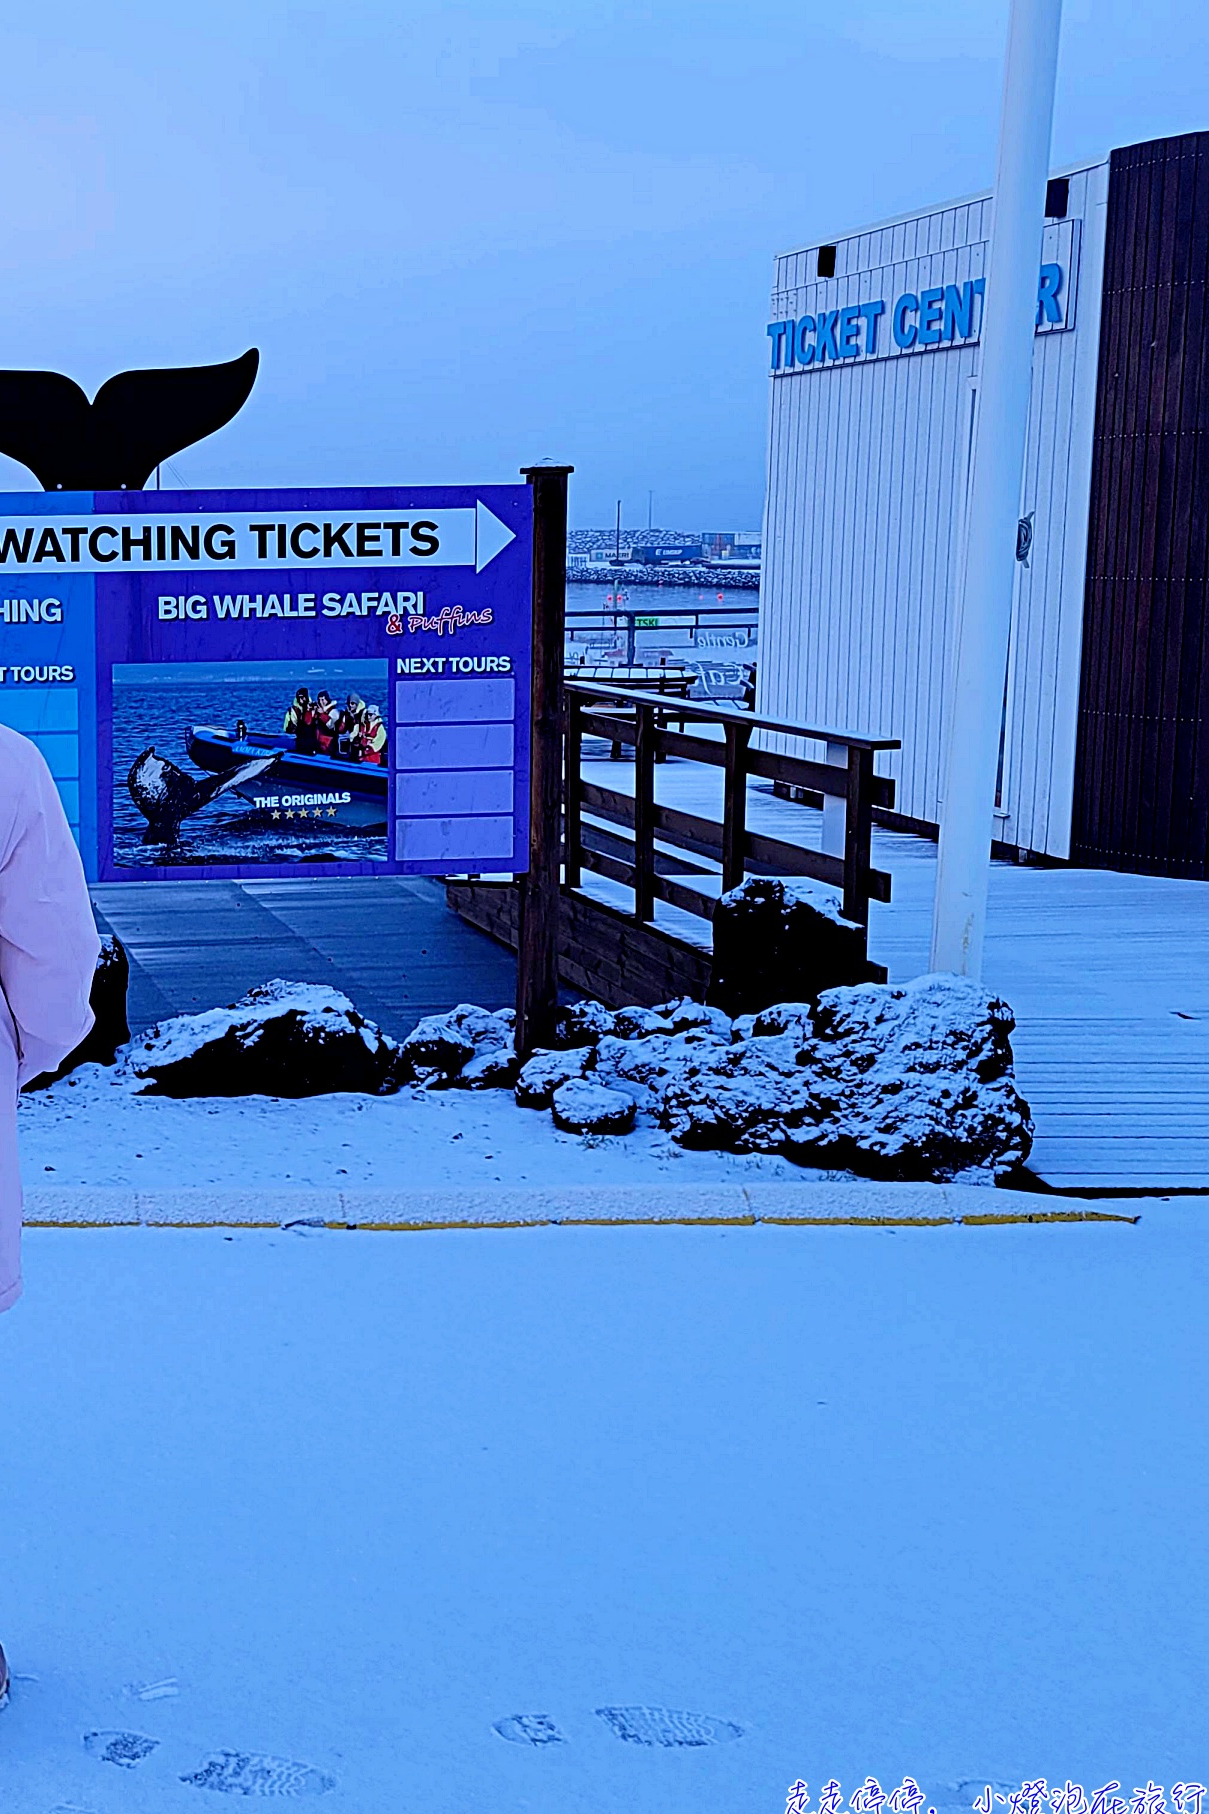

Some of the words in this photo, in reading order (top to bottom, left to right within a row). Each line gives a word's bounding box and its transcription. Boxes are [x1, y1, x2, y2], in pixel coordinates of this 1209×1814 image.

[767, 300, 884, 370] TICKET
[892, 263, 1063, 349] CENR
[249, 520, 440, 560] TICKETS
[158, 596, 207, 620] BIG
[213, 593, 316, 619] WHALE
[322, 591, 424, 617] SAFARI
[386, 614, 403, 635] &
[10, 666, 74, 682] TOURS
[396, 657, 447, 674] NEXT
[449, 656, 511, 673] TOURS
[254, 796, 278, 809] THE
[281, 792, 351, 808] ORIGINALS
